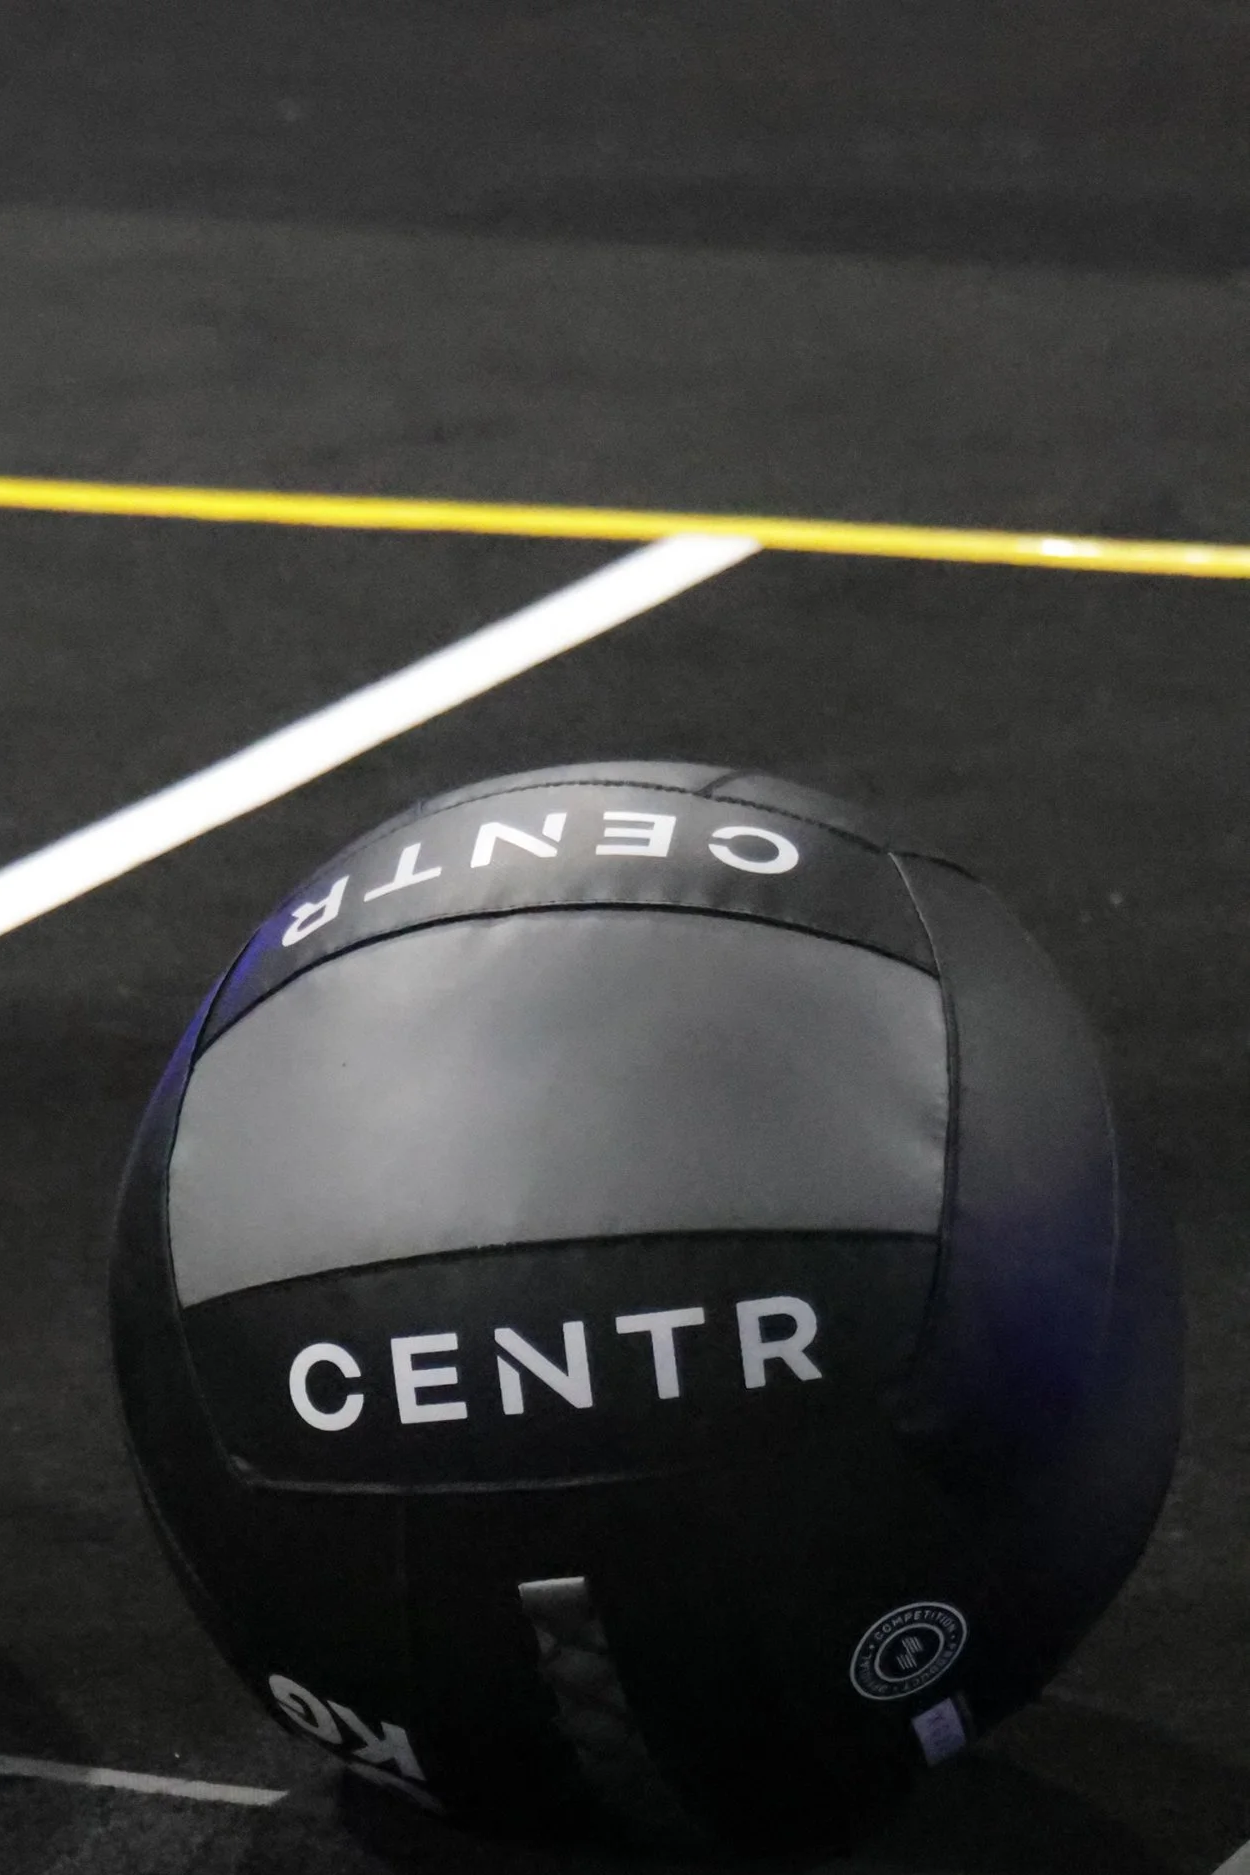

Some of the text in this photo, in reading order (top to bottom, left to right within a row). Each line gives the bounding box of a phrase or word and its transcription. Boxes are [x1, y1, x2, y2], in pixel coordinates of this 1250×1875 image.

[282, 809, 800, 948] CENTR
[289, 1296, 823, 1432] CENTR
[268, 1673, 428, 1782] KG
